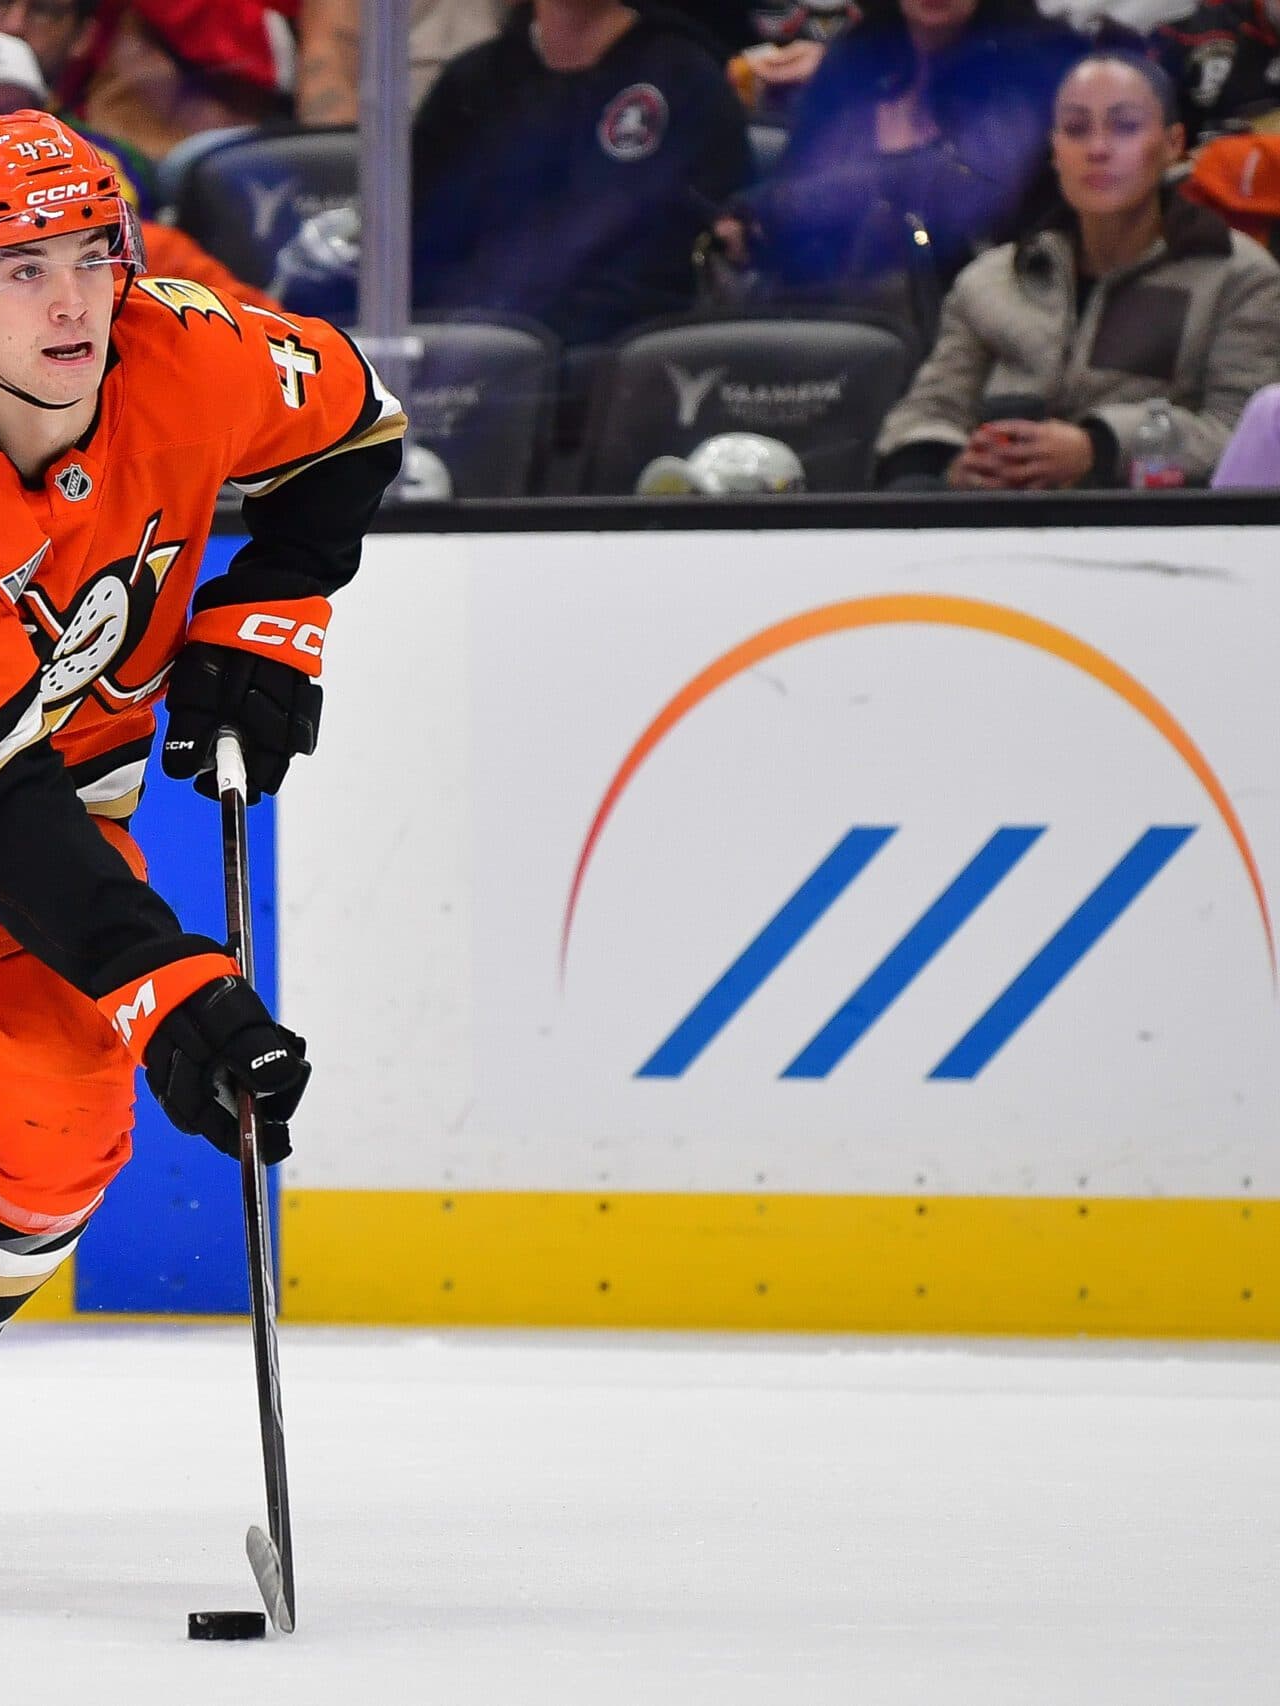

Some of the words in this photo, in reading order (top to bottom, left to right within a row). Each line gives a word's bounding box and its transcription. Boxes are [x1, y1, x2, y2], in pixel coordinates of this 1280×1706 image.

[14, 137, 65, 161] 45
[26, 181, 90, 207] CCM
[250, 1049, 289, 1071] CCM
